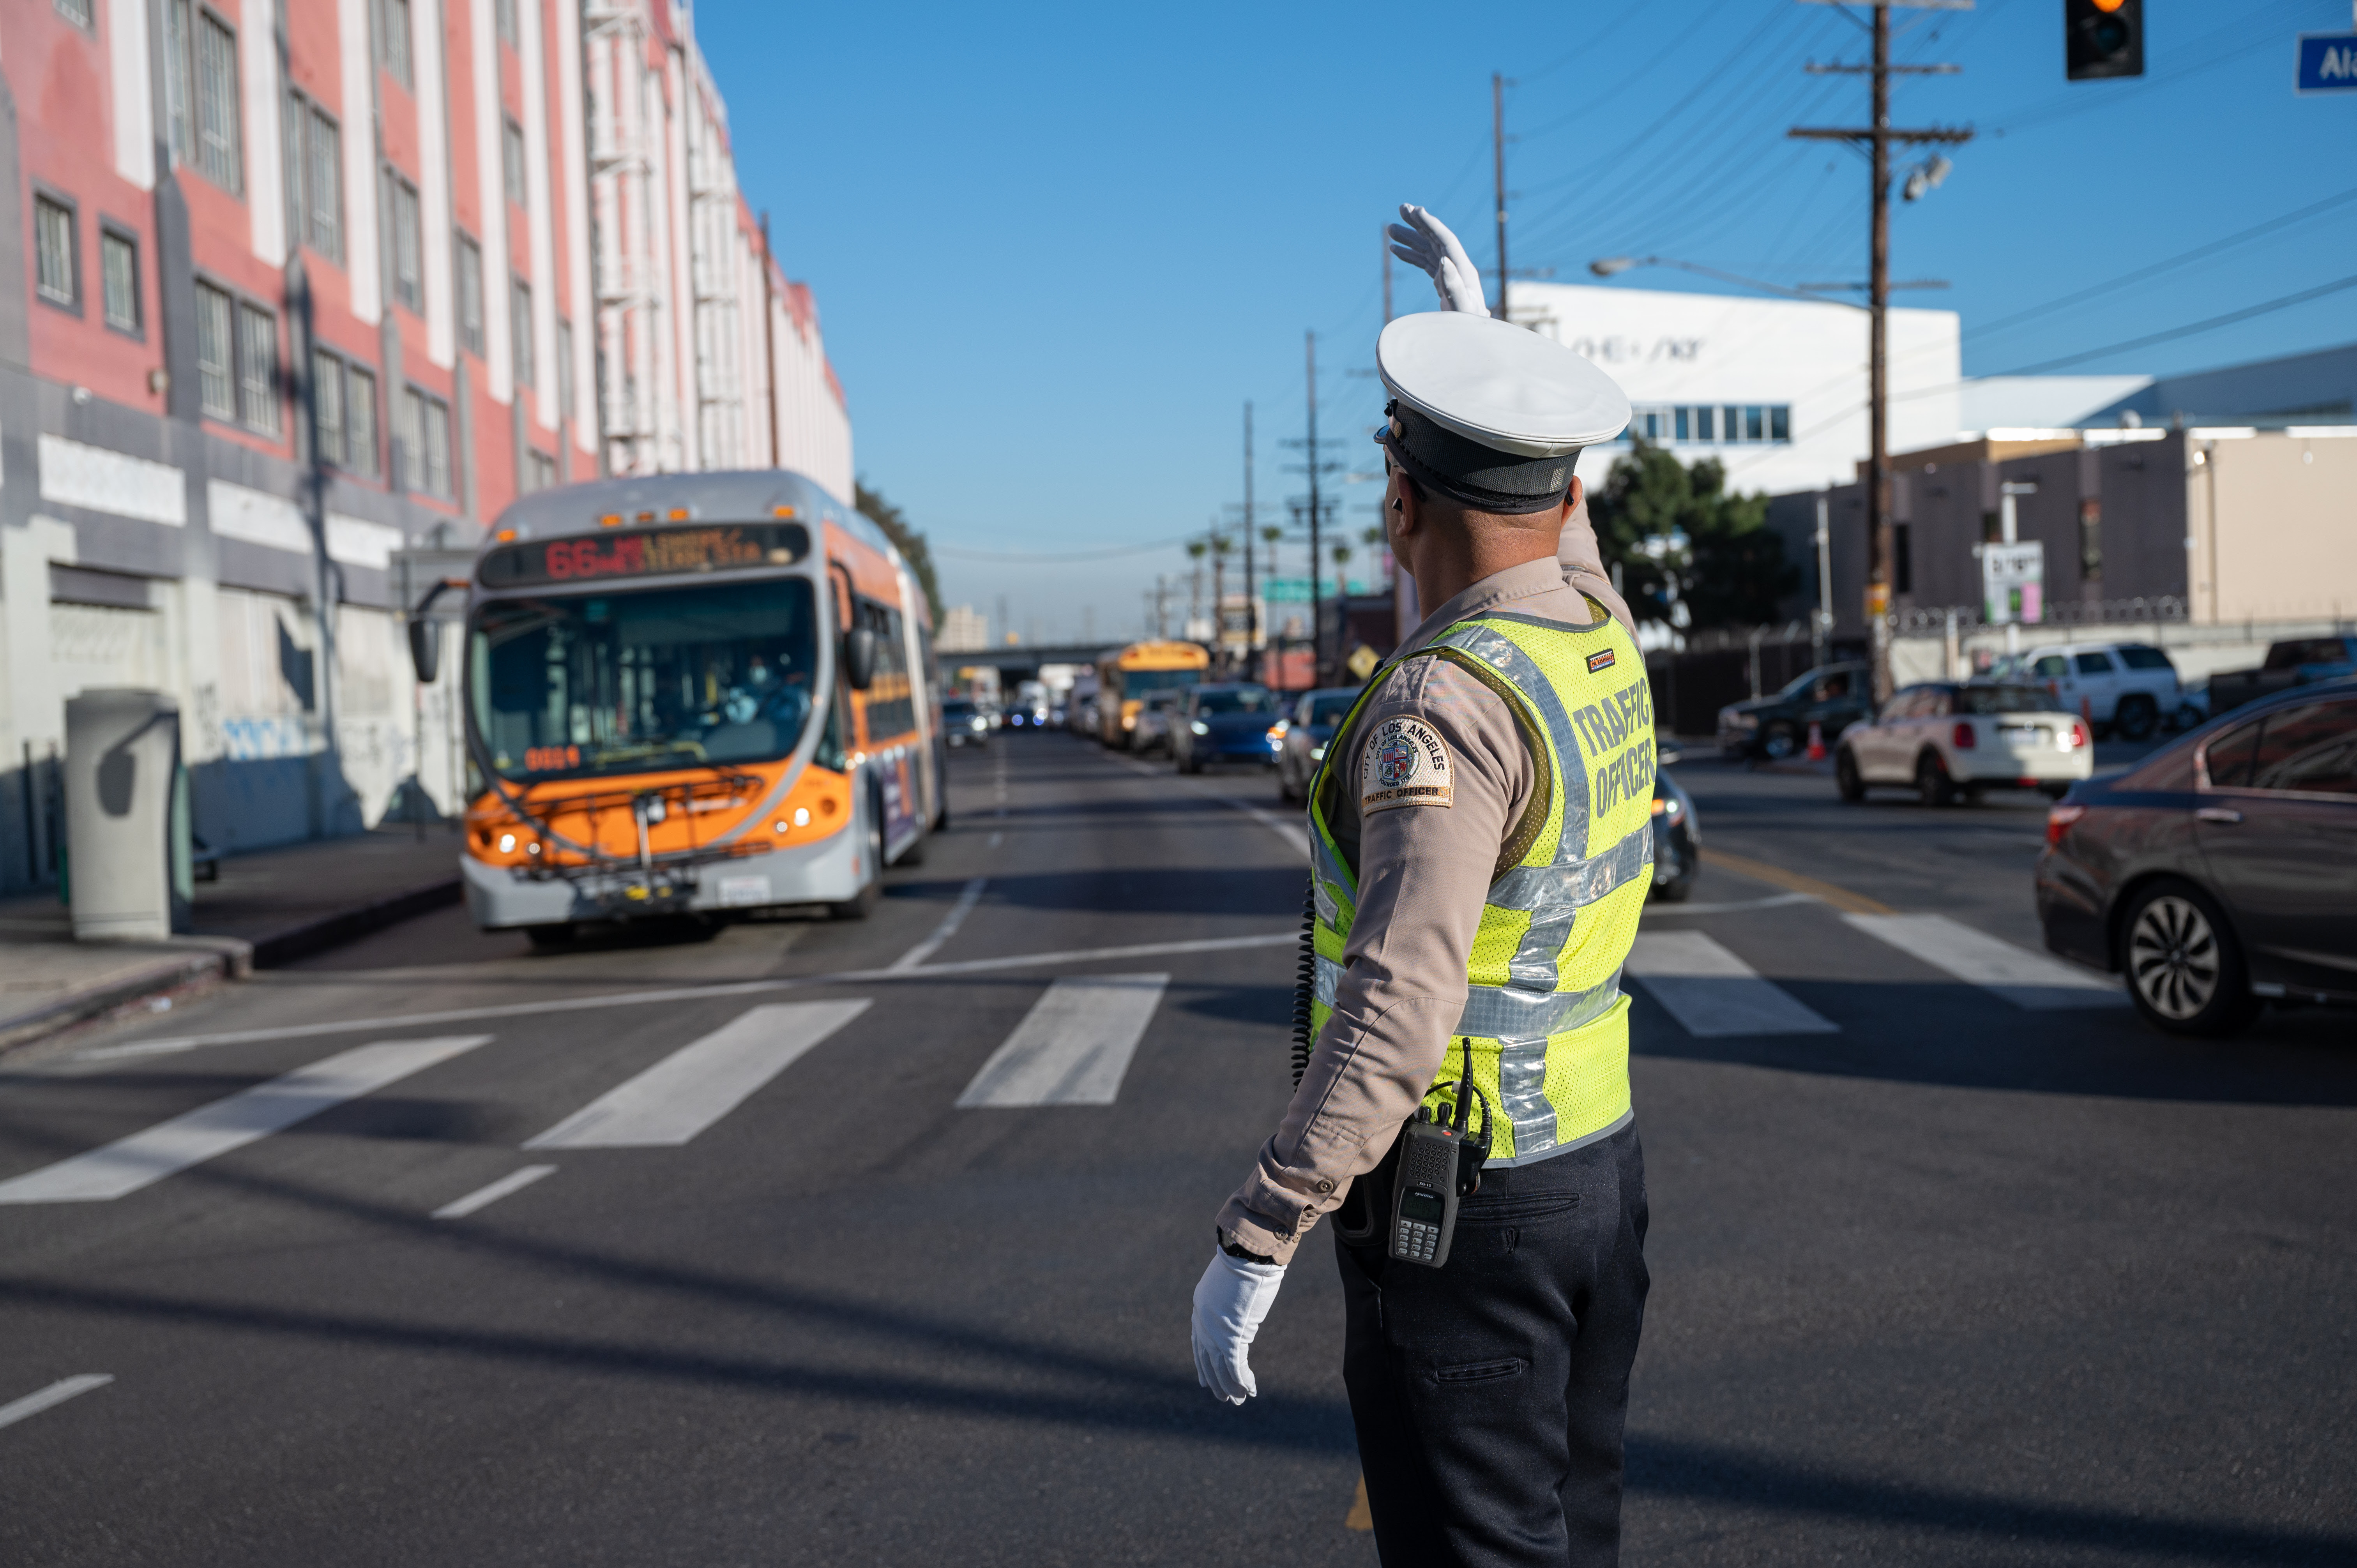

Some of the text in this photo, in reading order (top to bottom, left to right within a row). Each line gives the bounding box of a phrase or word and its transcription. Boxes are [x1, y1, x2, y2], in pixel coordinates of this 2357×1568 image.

[546, 540, 598, 579] 66
[1572, 677, 1650, 757] TRAFFIC
[1369, 734, 1378, 750] OF
[1382, 722, 1403, 737] LOS
[1407, 724, 1445, 770] ANGELES
[1399, 735, 1418, 753] ANGELES
[1365, 786, 1439, 805] TRAFFIC OFFICER
[1379, 778, 1399, 787] FOUNDED
[1596, 737, 1656, 818] OFFICER
